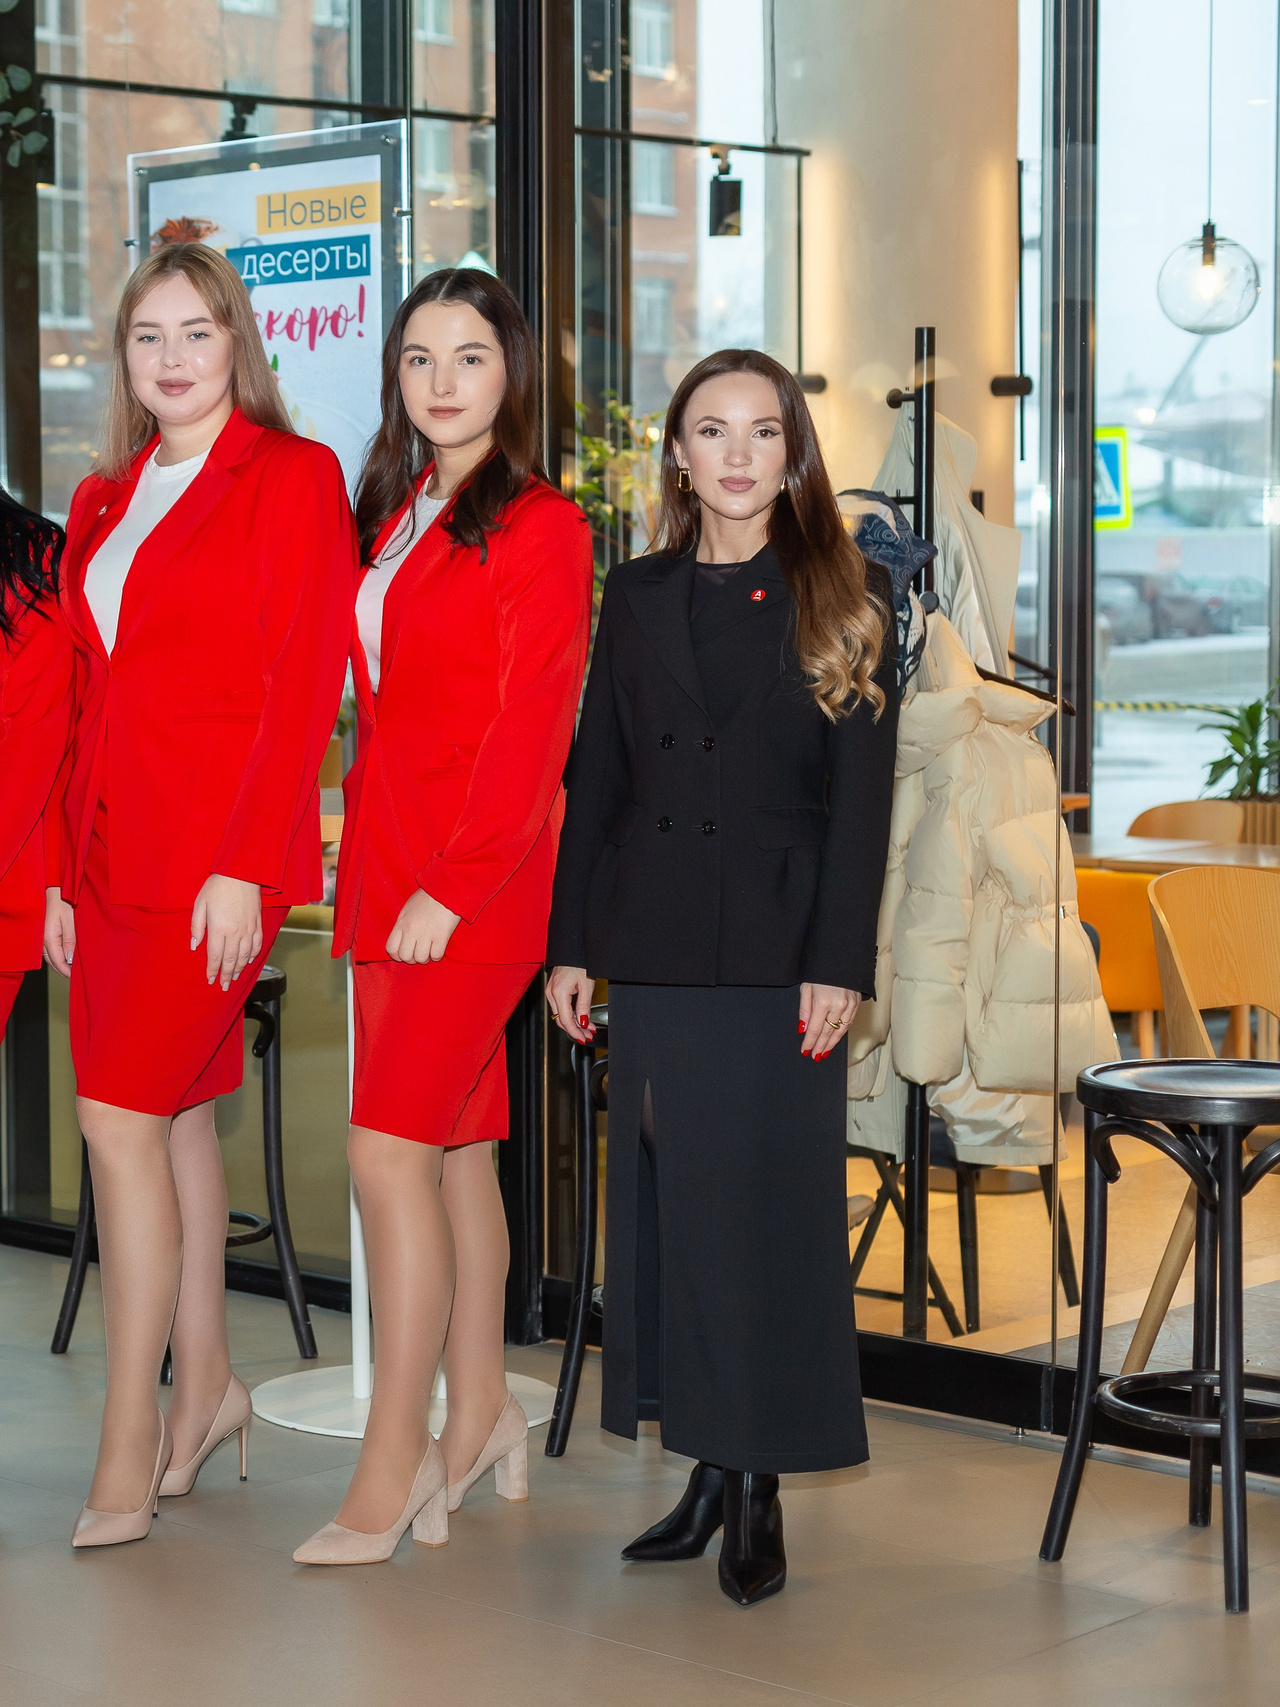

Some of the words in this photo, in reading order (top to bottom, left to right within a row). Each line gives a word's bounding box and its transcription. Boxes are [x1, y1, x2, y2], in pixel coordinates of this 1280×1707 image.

[267, 193, 367, 228] Новые
[240, 243, 367, 284] десерты
[253, 283, 366, 352] коро!
